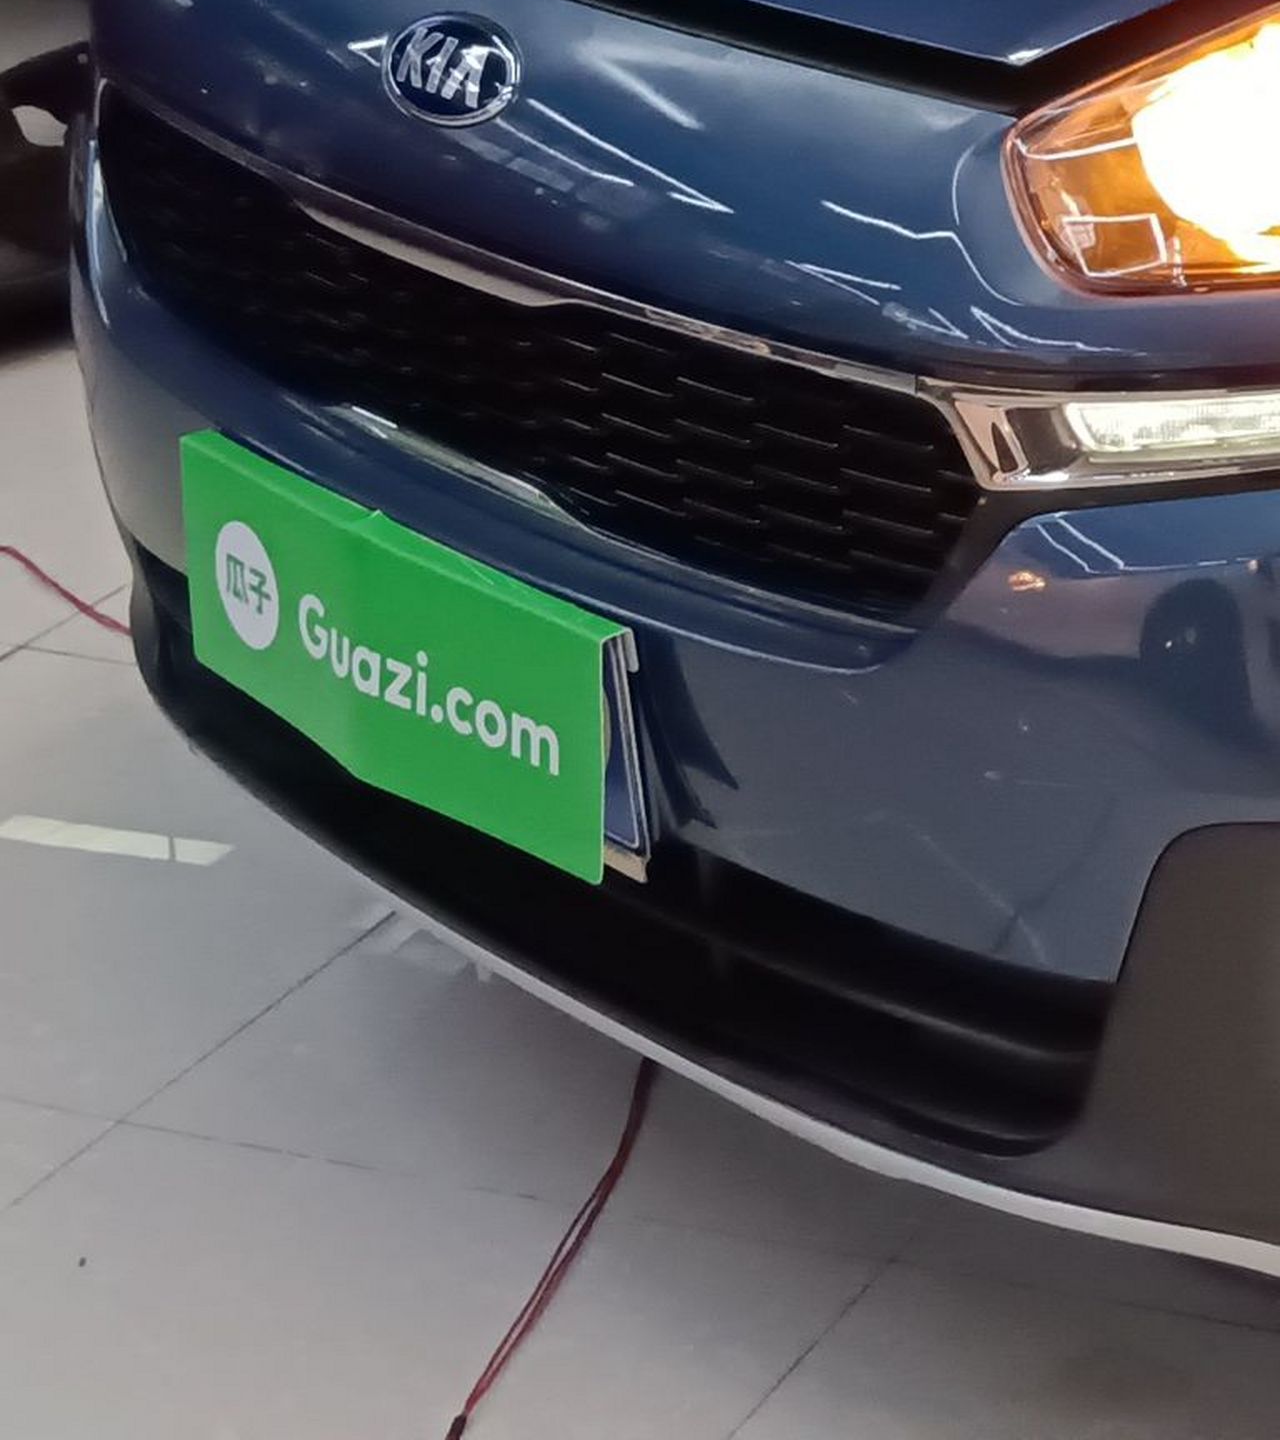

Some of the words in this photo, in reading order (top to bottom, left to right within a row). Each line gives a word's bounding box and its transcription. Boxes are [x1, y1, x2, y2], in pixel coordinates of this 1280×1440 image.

[396, 26, 489, 110] KIA
[225, 553, 272, 615] 瓜子
[298, 594, 560, 777] Guazi.com
